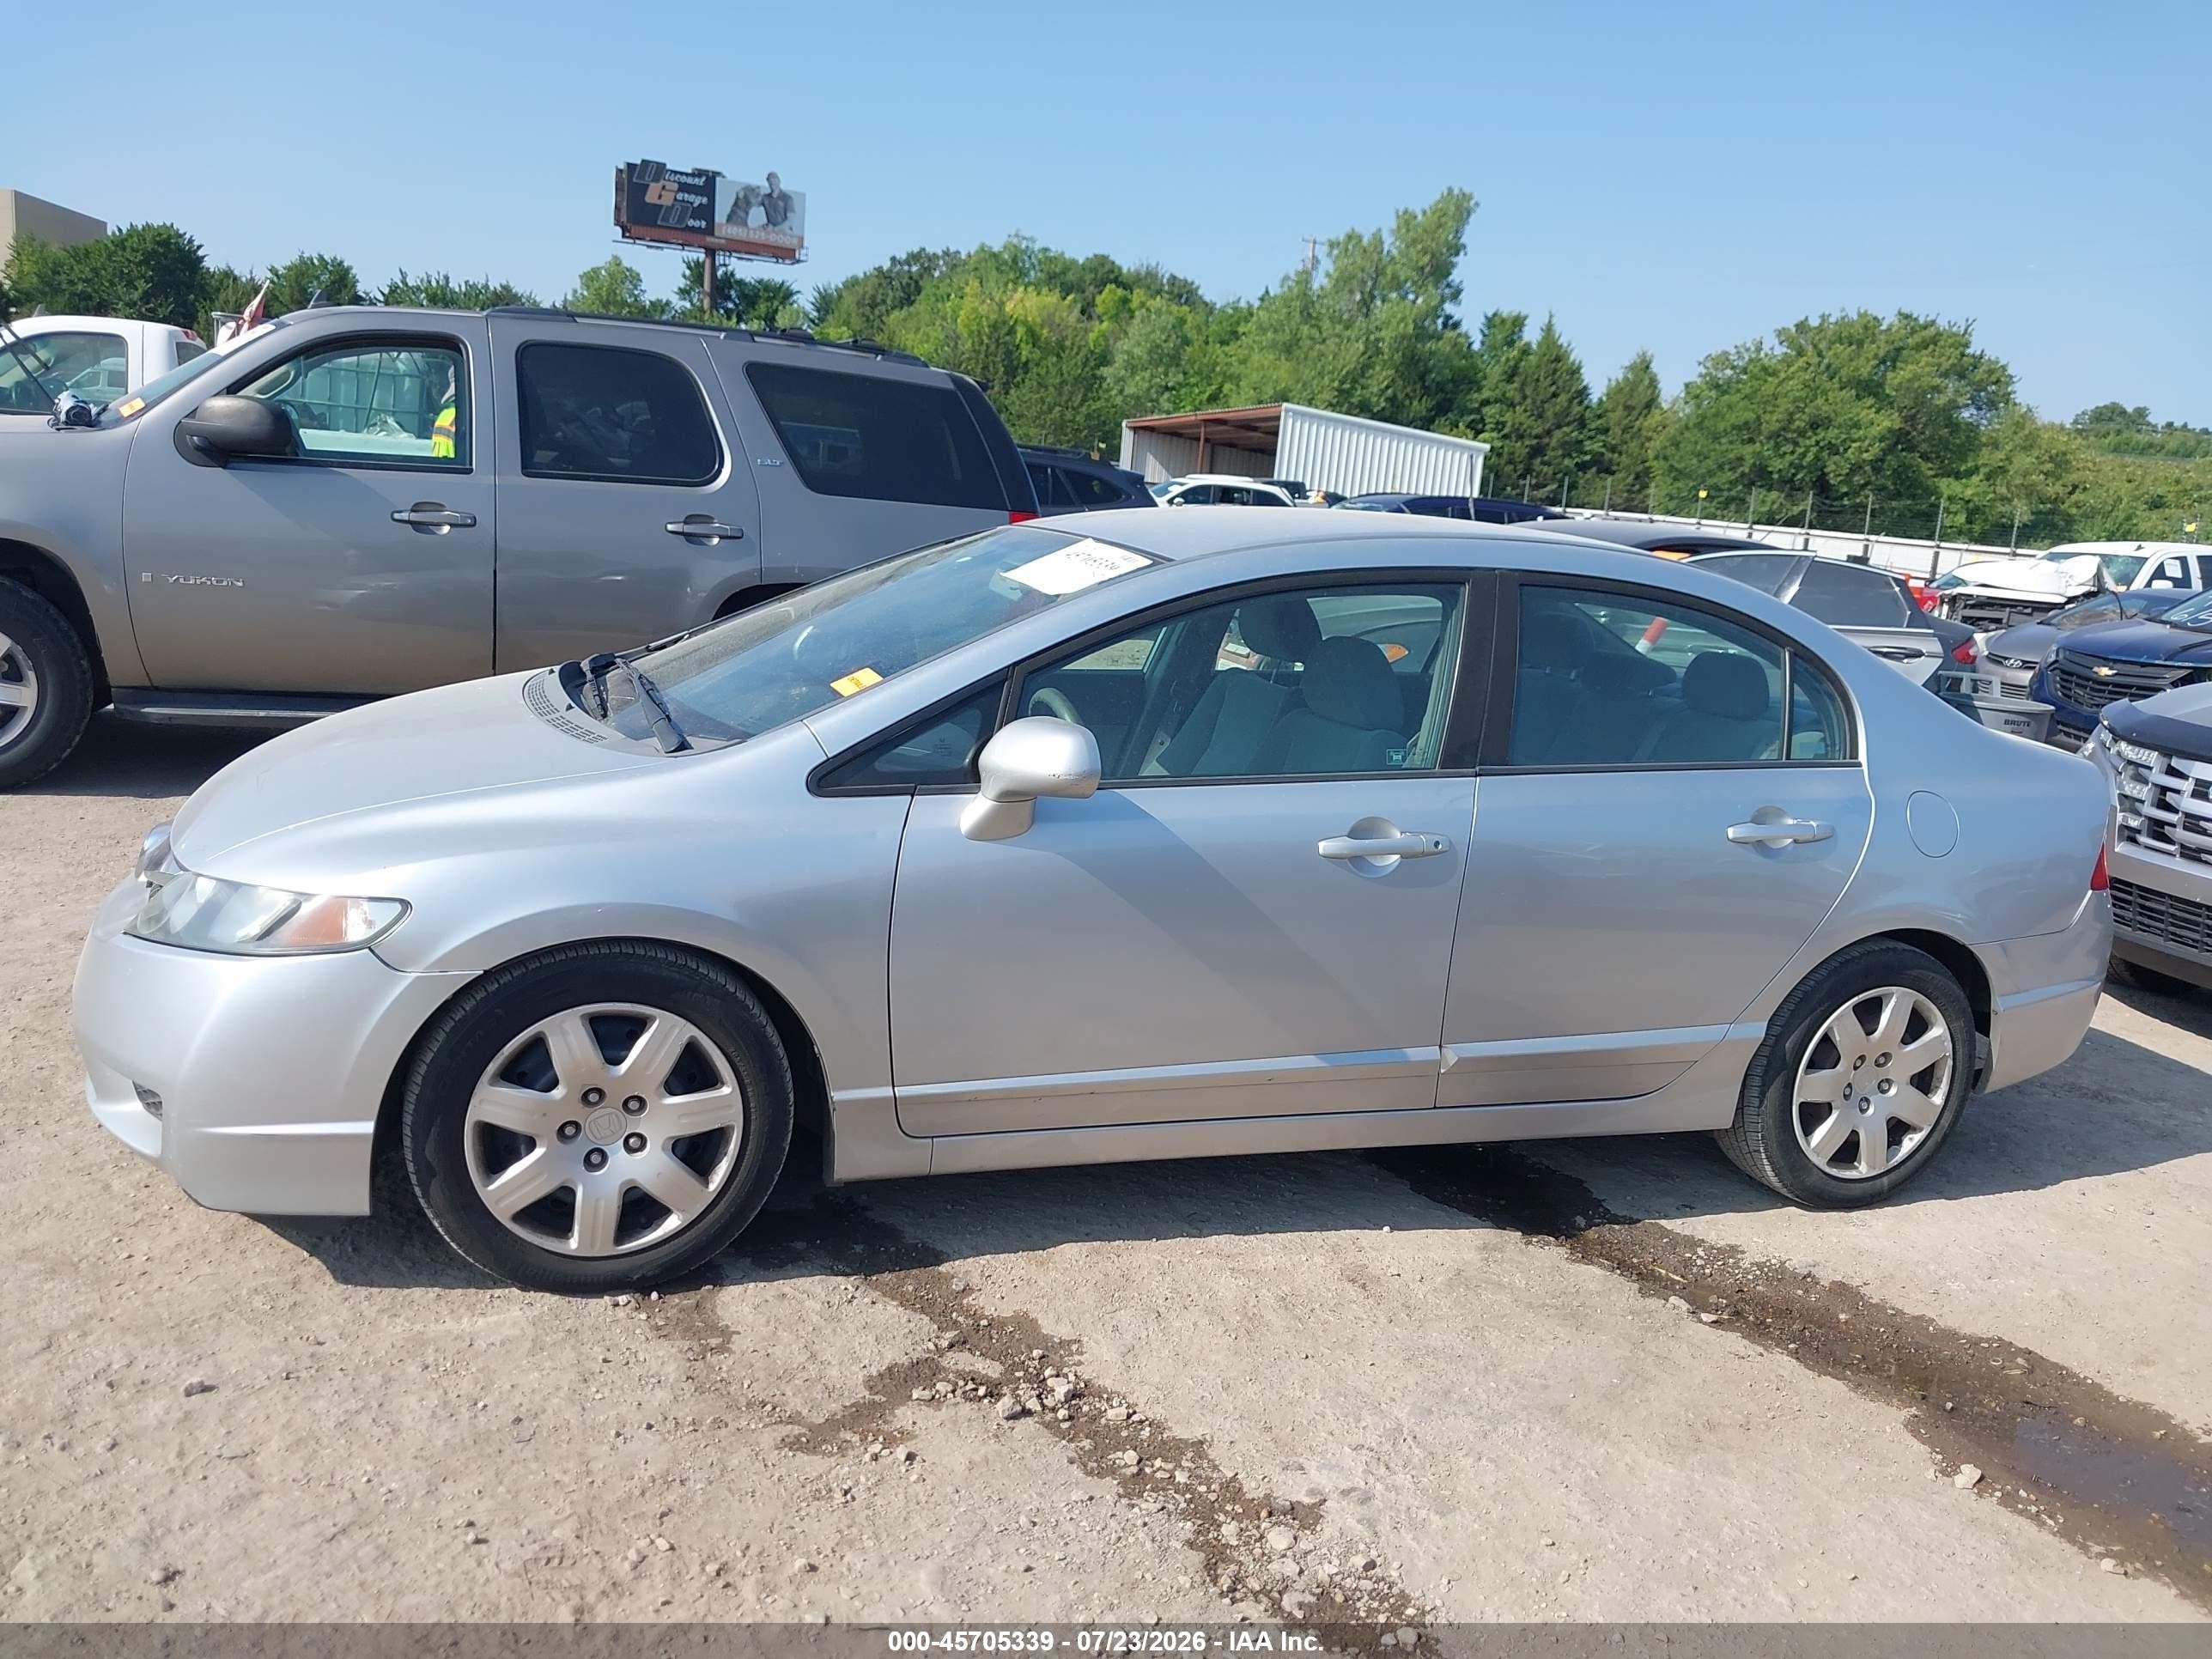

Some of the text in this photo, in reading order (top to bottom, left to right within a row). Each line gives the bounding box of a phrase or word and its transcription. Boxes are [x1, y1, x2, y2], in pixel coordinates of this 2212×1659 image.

[633, 159, 707, 185] Discount
[645, 179, 708, 208] Garage
[657, 202, 707, 228] Door
[161, 574, 244, 586] YUKON
[2003, 719, 2031, 727] BRUTE
